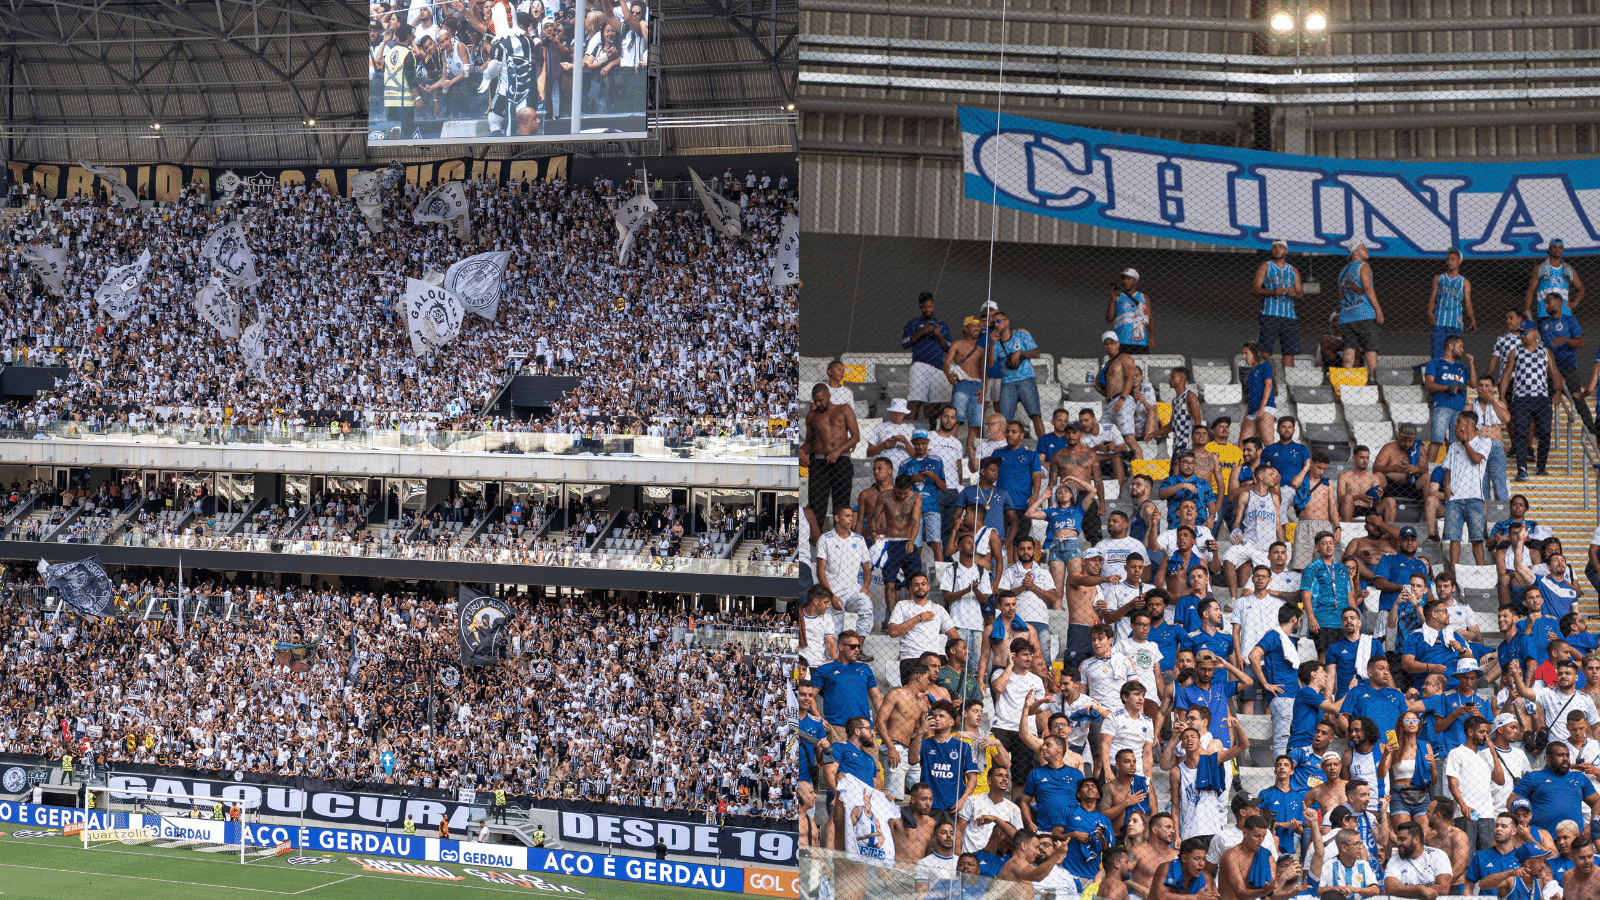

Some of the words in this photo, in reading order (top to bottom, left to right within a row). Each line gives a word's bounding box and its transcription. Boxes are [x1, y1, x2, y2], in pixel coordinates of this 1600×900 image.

[973, 129, 1600, 254] CHINA
[1442, 372, 1464, 384] CAIXA
[933, 762, 952, 772] FIAT
[109, 775, 487, 831] GALOUCURA
[35, 806, 115, 830] GERDAU
[164, 826, 211, 841] GERDAU
[240, 826, 289, 847] AÇO
[320, 829, 411, 857] GERDAU
[562, 811, 720, 854] DESDE
[731, 829, 799, 861] 19
[463, 851, 514, 868] GERDAU
[543, 853, 594, 876] AÇO
[625, 859, 726, 888] GERDAU
[750, 873, 783, 892] GOL
